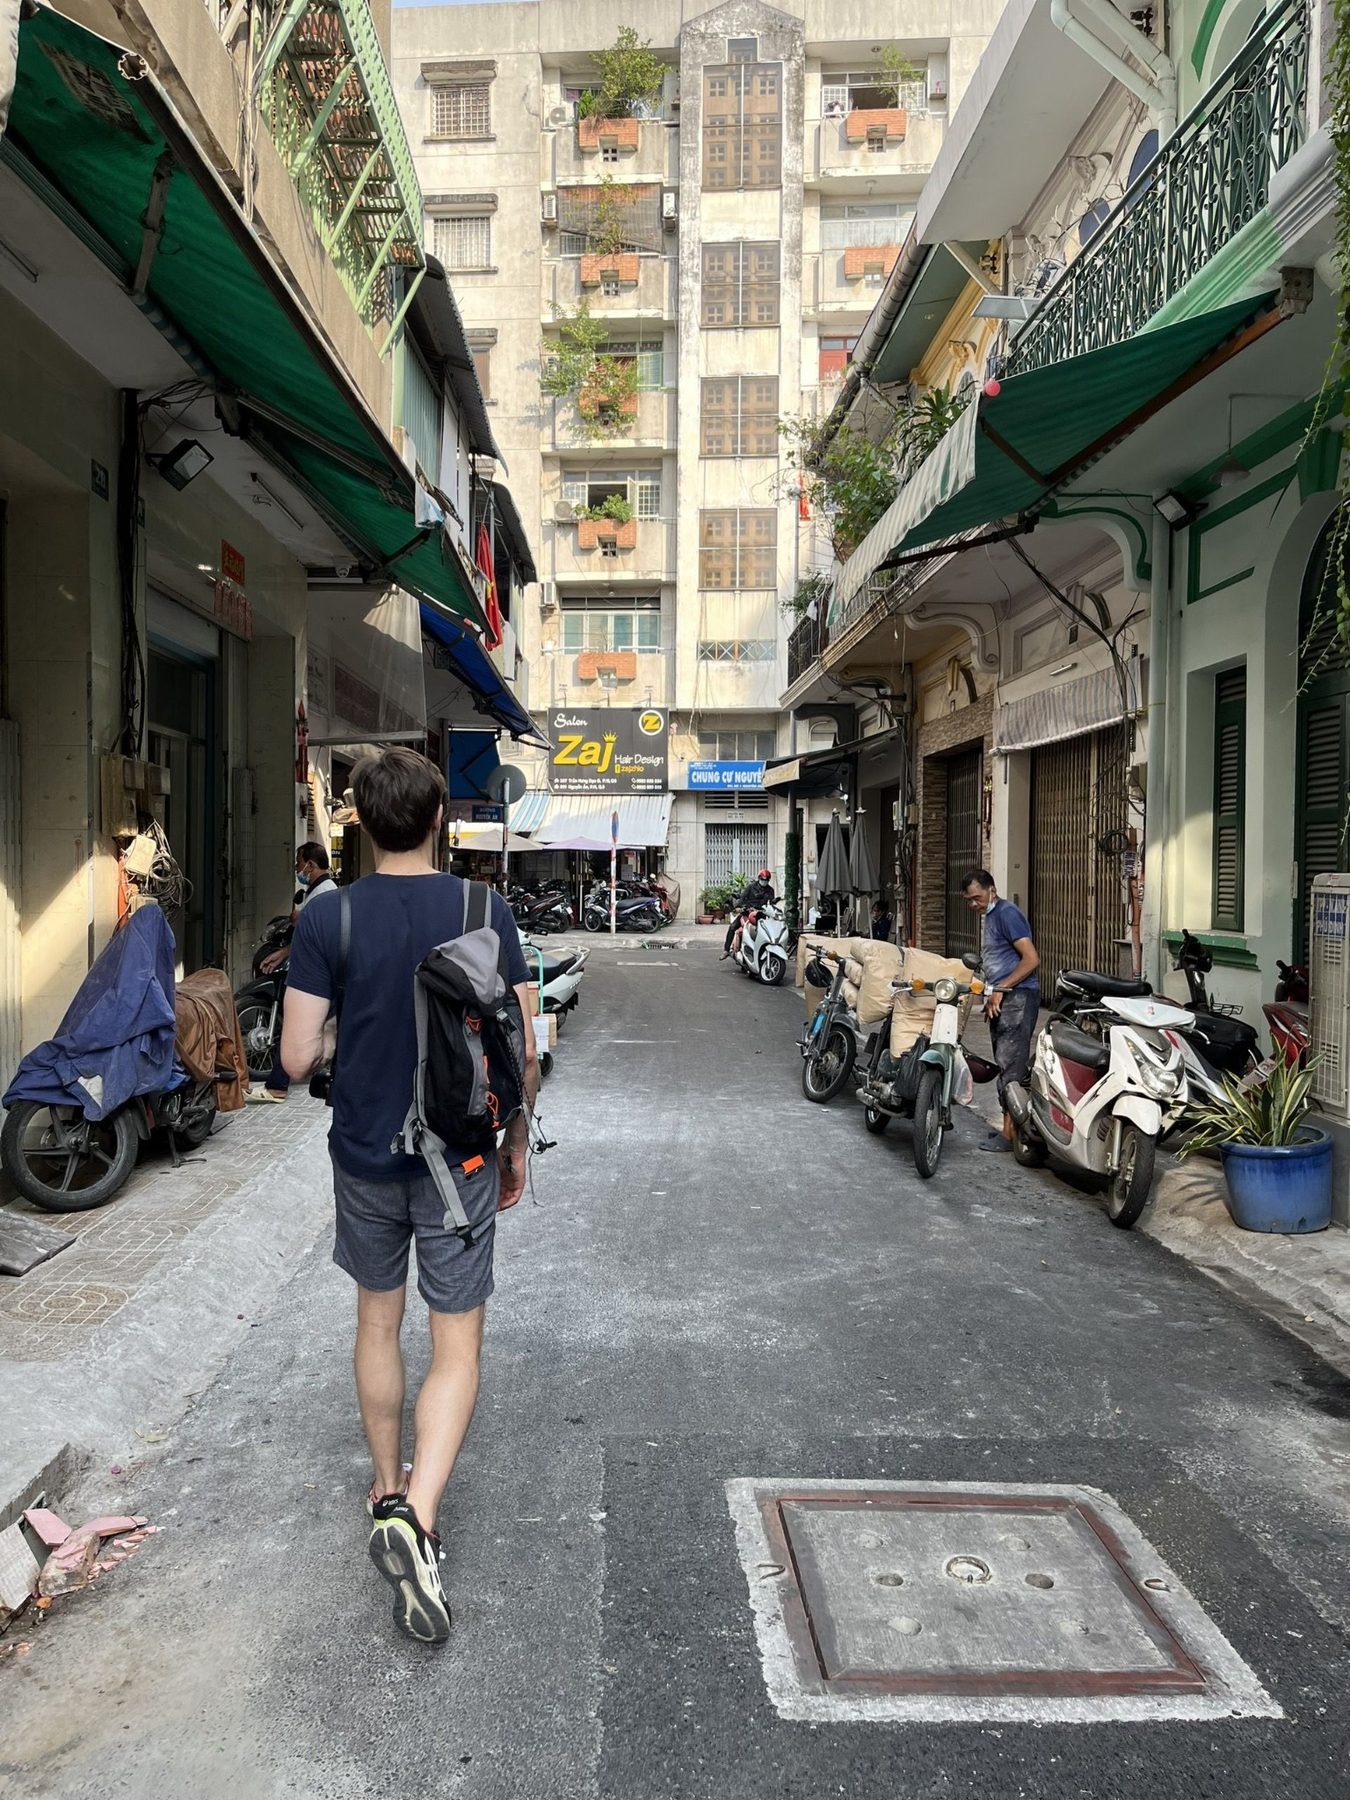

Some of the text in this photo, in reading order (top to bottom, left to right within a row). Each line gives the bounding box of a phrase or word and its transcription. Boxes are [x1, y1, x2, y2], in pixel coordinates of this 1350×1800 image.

[553, 713, 588, 728] Salon
[643, 715, 660, 730] Z
[553, 733, 616, 773] Zaj
[614, 754, 664, 767] Hair Design
[691, 770, 720, 784] CHUNG
[722, 770, 734, 784] CƯ
